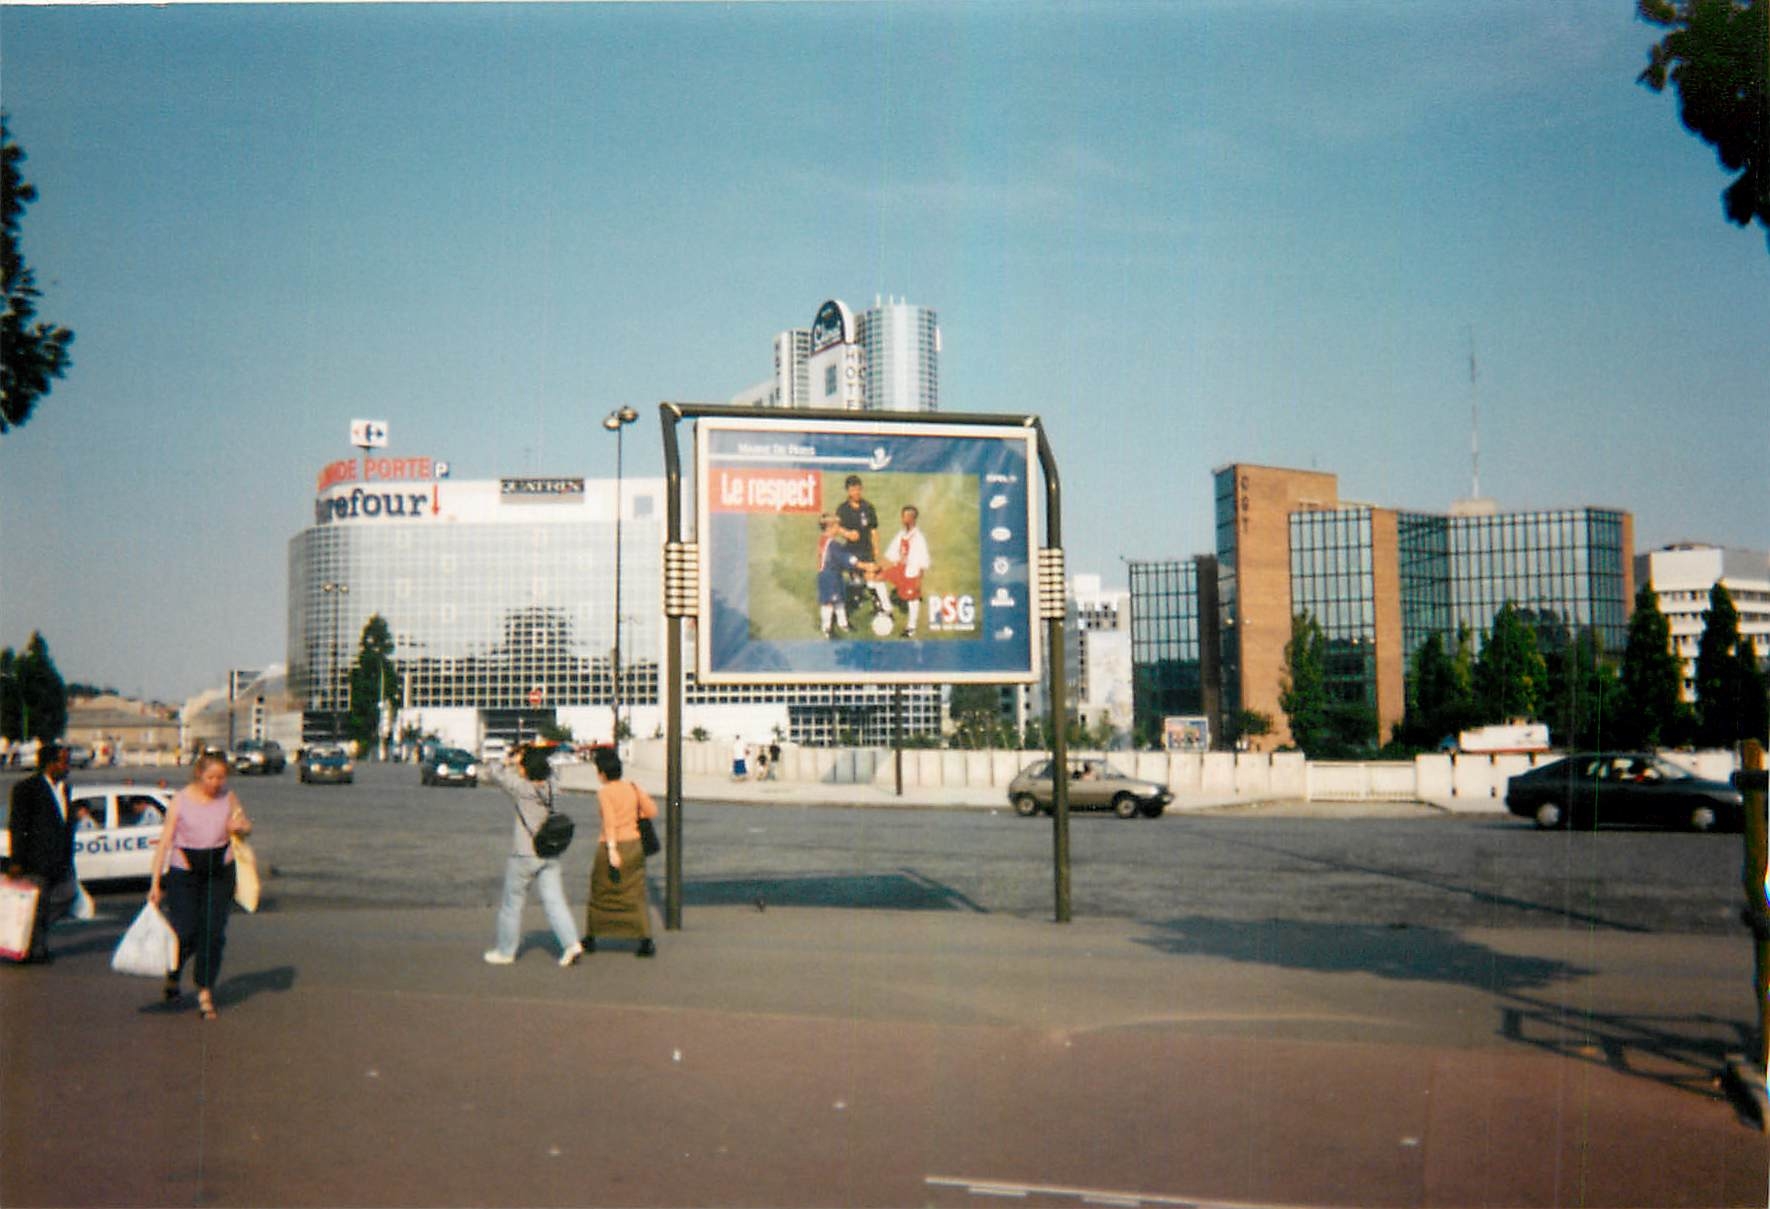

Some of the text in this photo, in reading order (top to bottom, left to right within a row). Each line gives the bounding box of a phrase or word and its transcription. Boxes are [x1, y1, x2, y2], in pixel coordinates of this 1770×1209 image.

[364, 456, 432, 480] PORTE
[320, 488, 427, 521] refour
[720, 473, 816, 512] Le respect
[928, 595, 975, 624] PSG
[75, 837, 148, 854] POLICE
